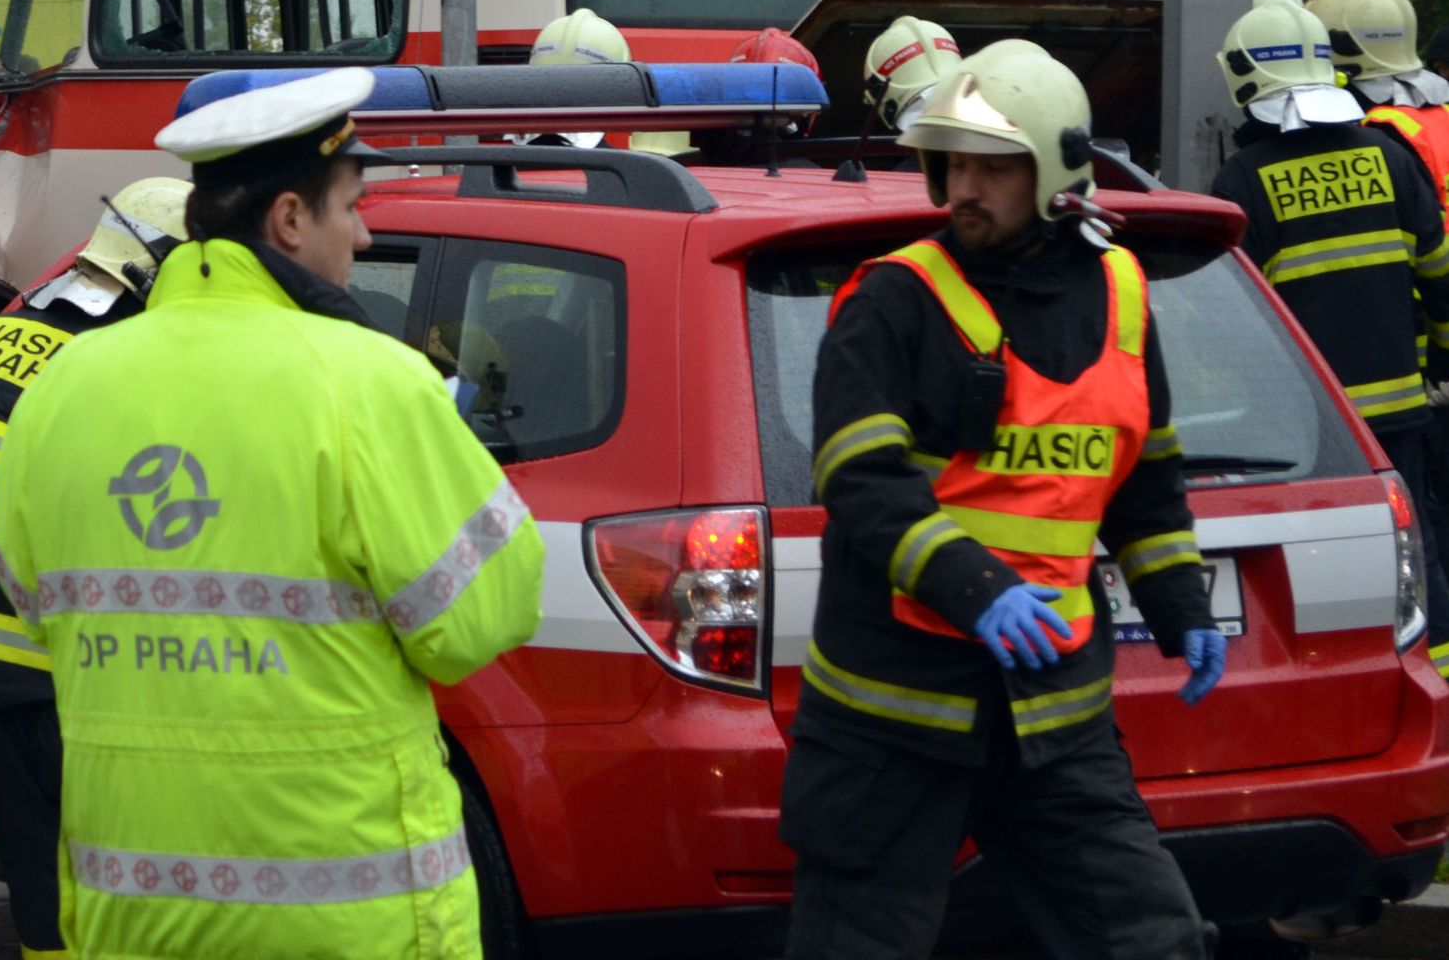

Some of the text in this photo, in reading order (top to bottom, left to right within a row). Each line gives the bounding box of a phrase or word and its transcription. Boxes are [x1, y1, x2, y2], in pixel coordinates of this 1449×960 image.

[1268, 152, 1383, 193] HASIČI
[1276, 178, 1389, 217] PRAHA
[985, 427, 1114, 470] HASIČI
[135, 633, 289, 675] PRAHA
